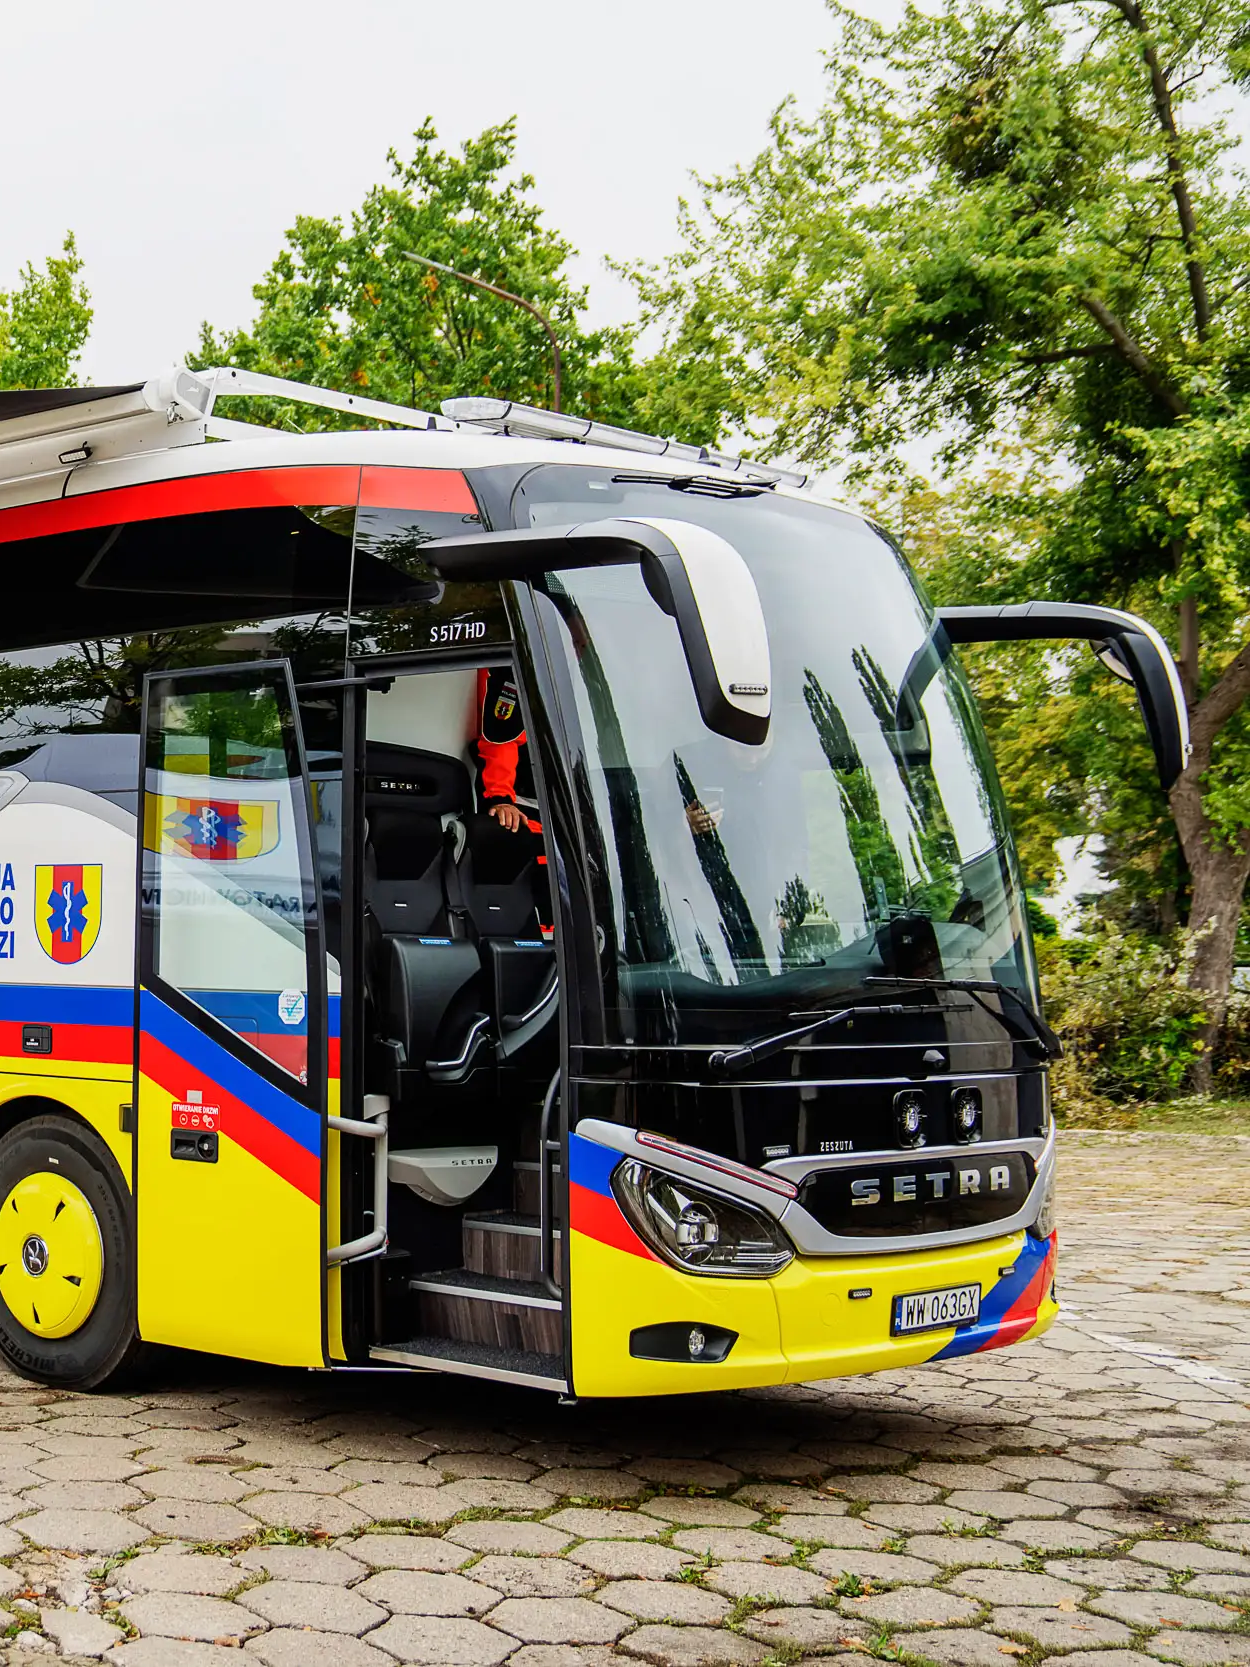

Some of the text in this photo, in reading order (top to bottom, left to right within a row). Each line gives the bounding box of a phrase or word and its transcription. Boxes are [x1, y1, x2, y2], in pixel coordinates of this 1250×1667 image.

[440, 624, 462, 642] 517
[464, 621, 486, 639] HD
[172, 1104, 219, 1115] OTWIERANIE DRZWI
[820, 1140, 854, 1152] ZESZUTA
[451, 1158, 493, 1166] SETRA
[851, 1165, 1011, 1207] SETRA
[906, 1289, 977, 1327] WW 063GX
